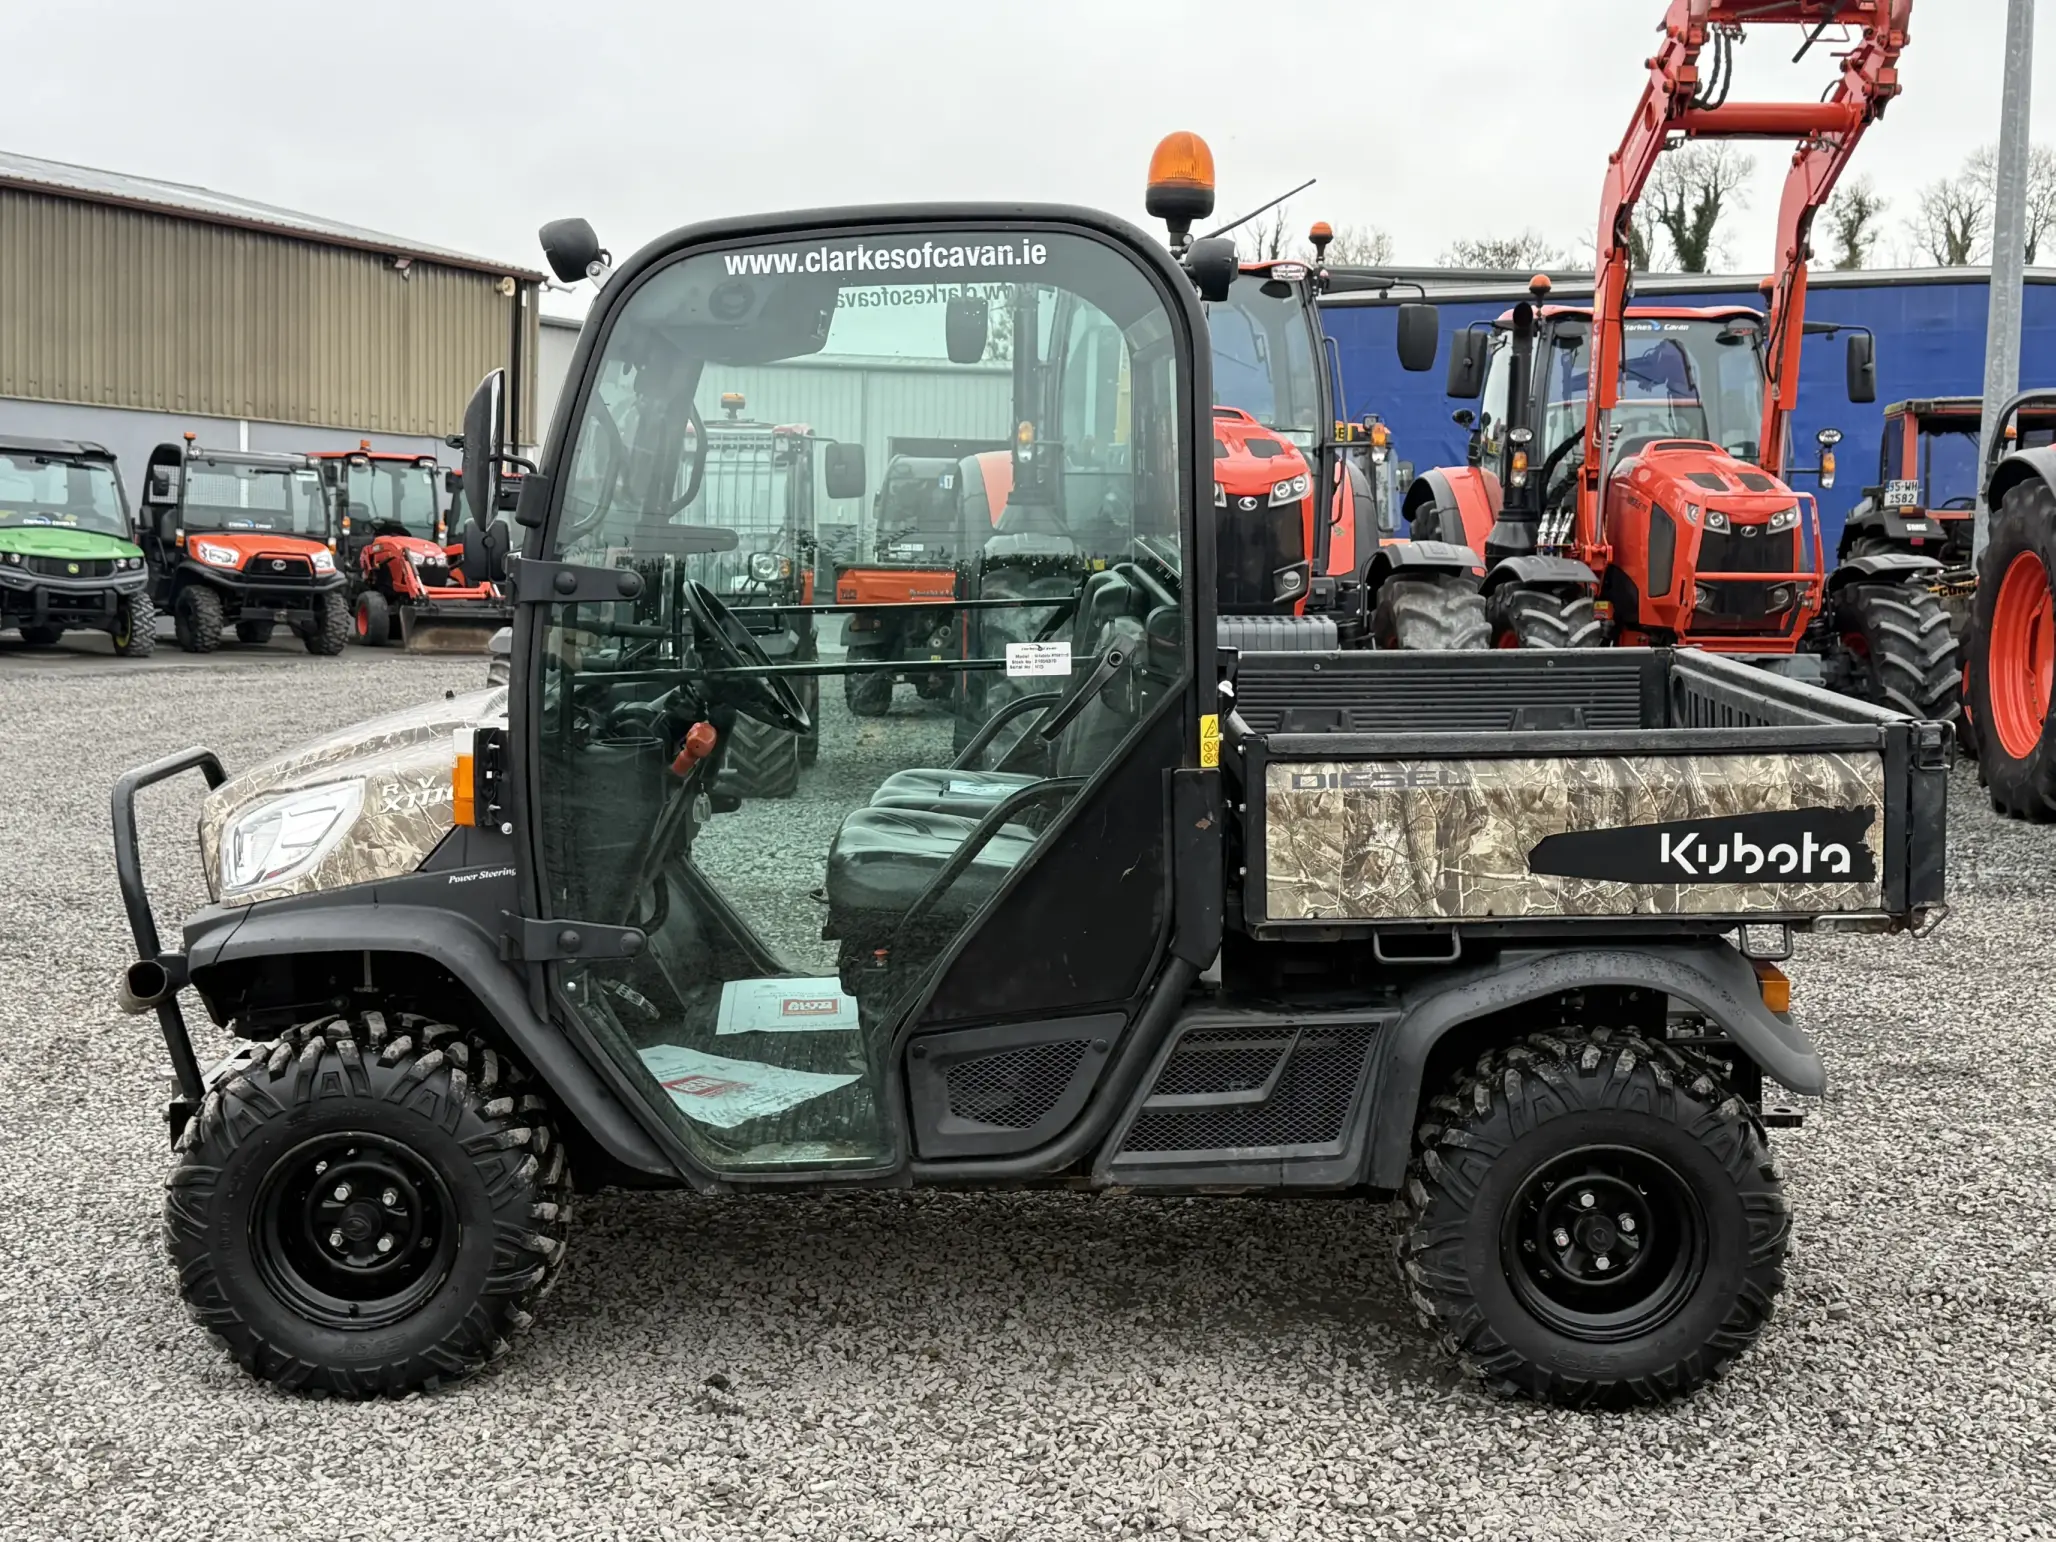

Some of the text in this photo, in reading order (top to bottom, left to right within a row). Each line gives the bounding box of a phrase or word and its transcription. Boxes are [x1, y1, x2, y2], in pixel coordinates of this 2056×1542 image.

[724, 239, 1047, 276] www.clarkesofcavan.ie
[1663, 323, 1690, 331] Cavan
[1889, 493, 1915, 504] 2582
[1292, 771, 1471, 789] DIESEL
[1660, 831, 1851, 875] Kubota
[448, 867, 517, 884] Power Steering
